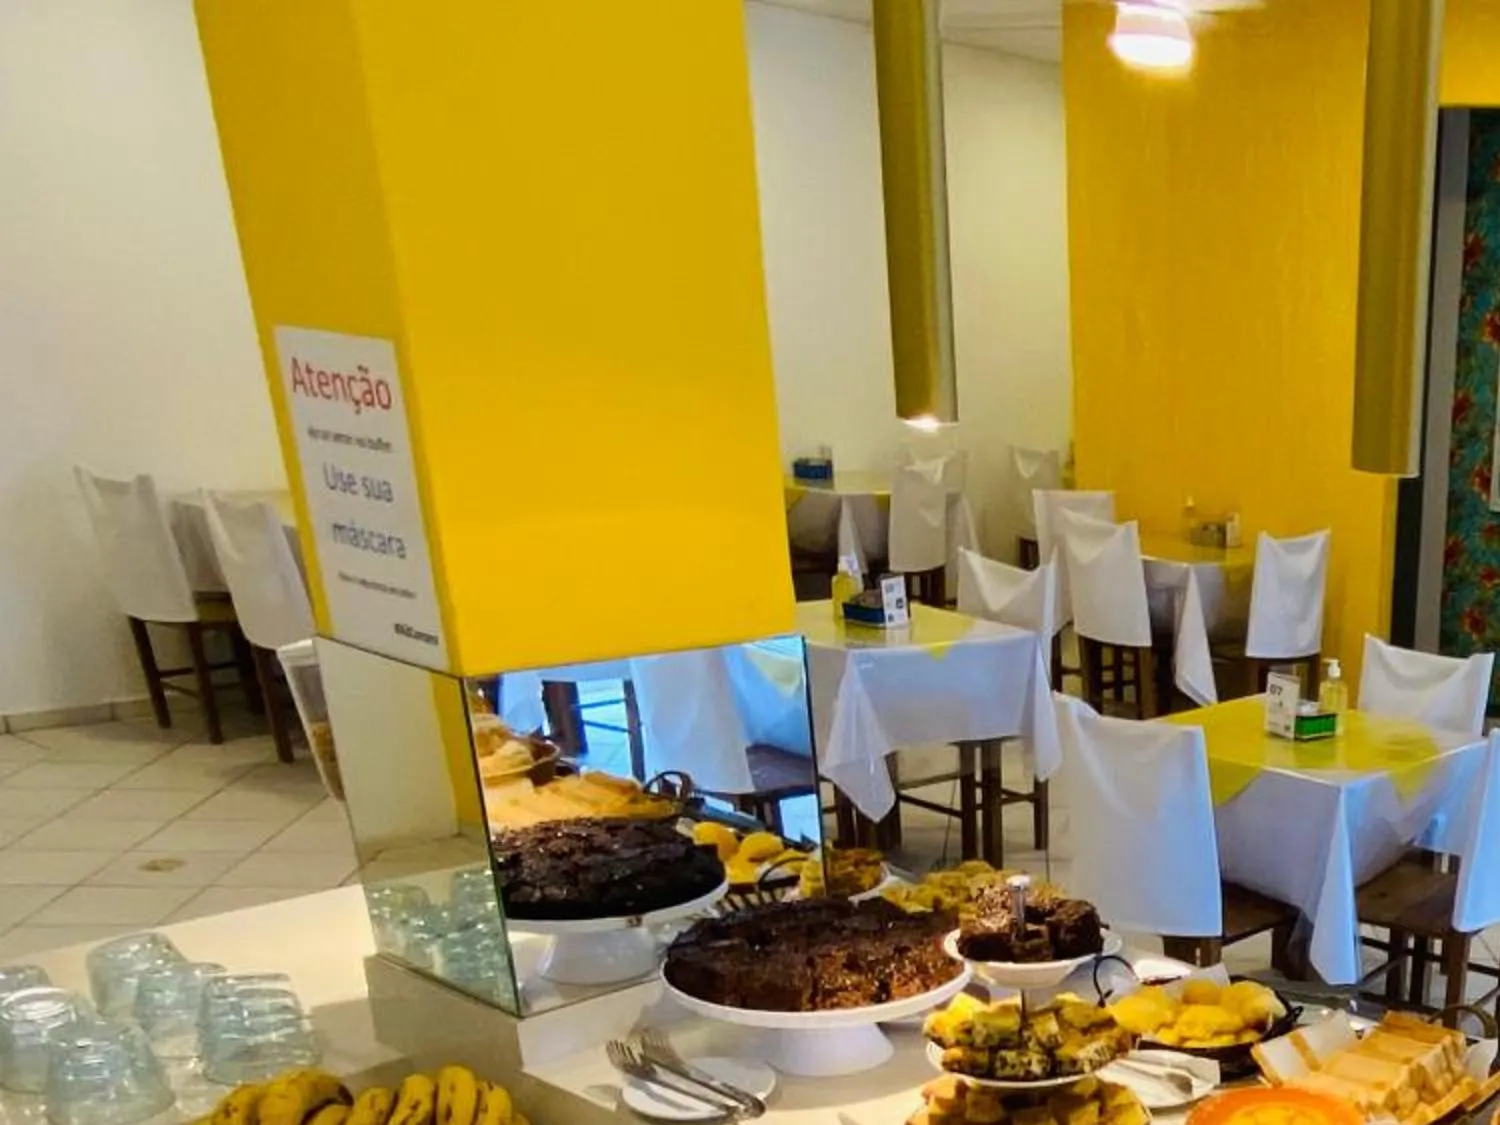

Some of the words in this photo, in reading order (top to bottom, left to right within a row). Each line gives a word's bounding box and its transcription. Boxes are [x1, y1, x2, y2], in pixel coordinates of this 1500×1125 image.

[290, 357, 393, 414] Atenção
[322, 465, 358, 497] Use
[362, 474, 394, 503] sua
[331, 522, 407, 559] máscara
